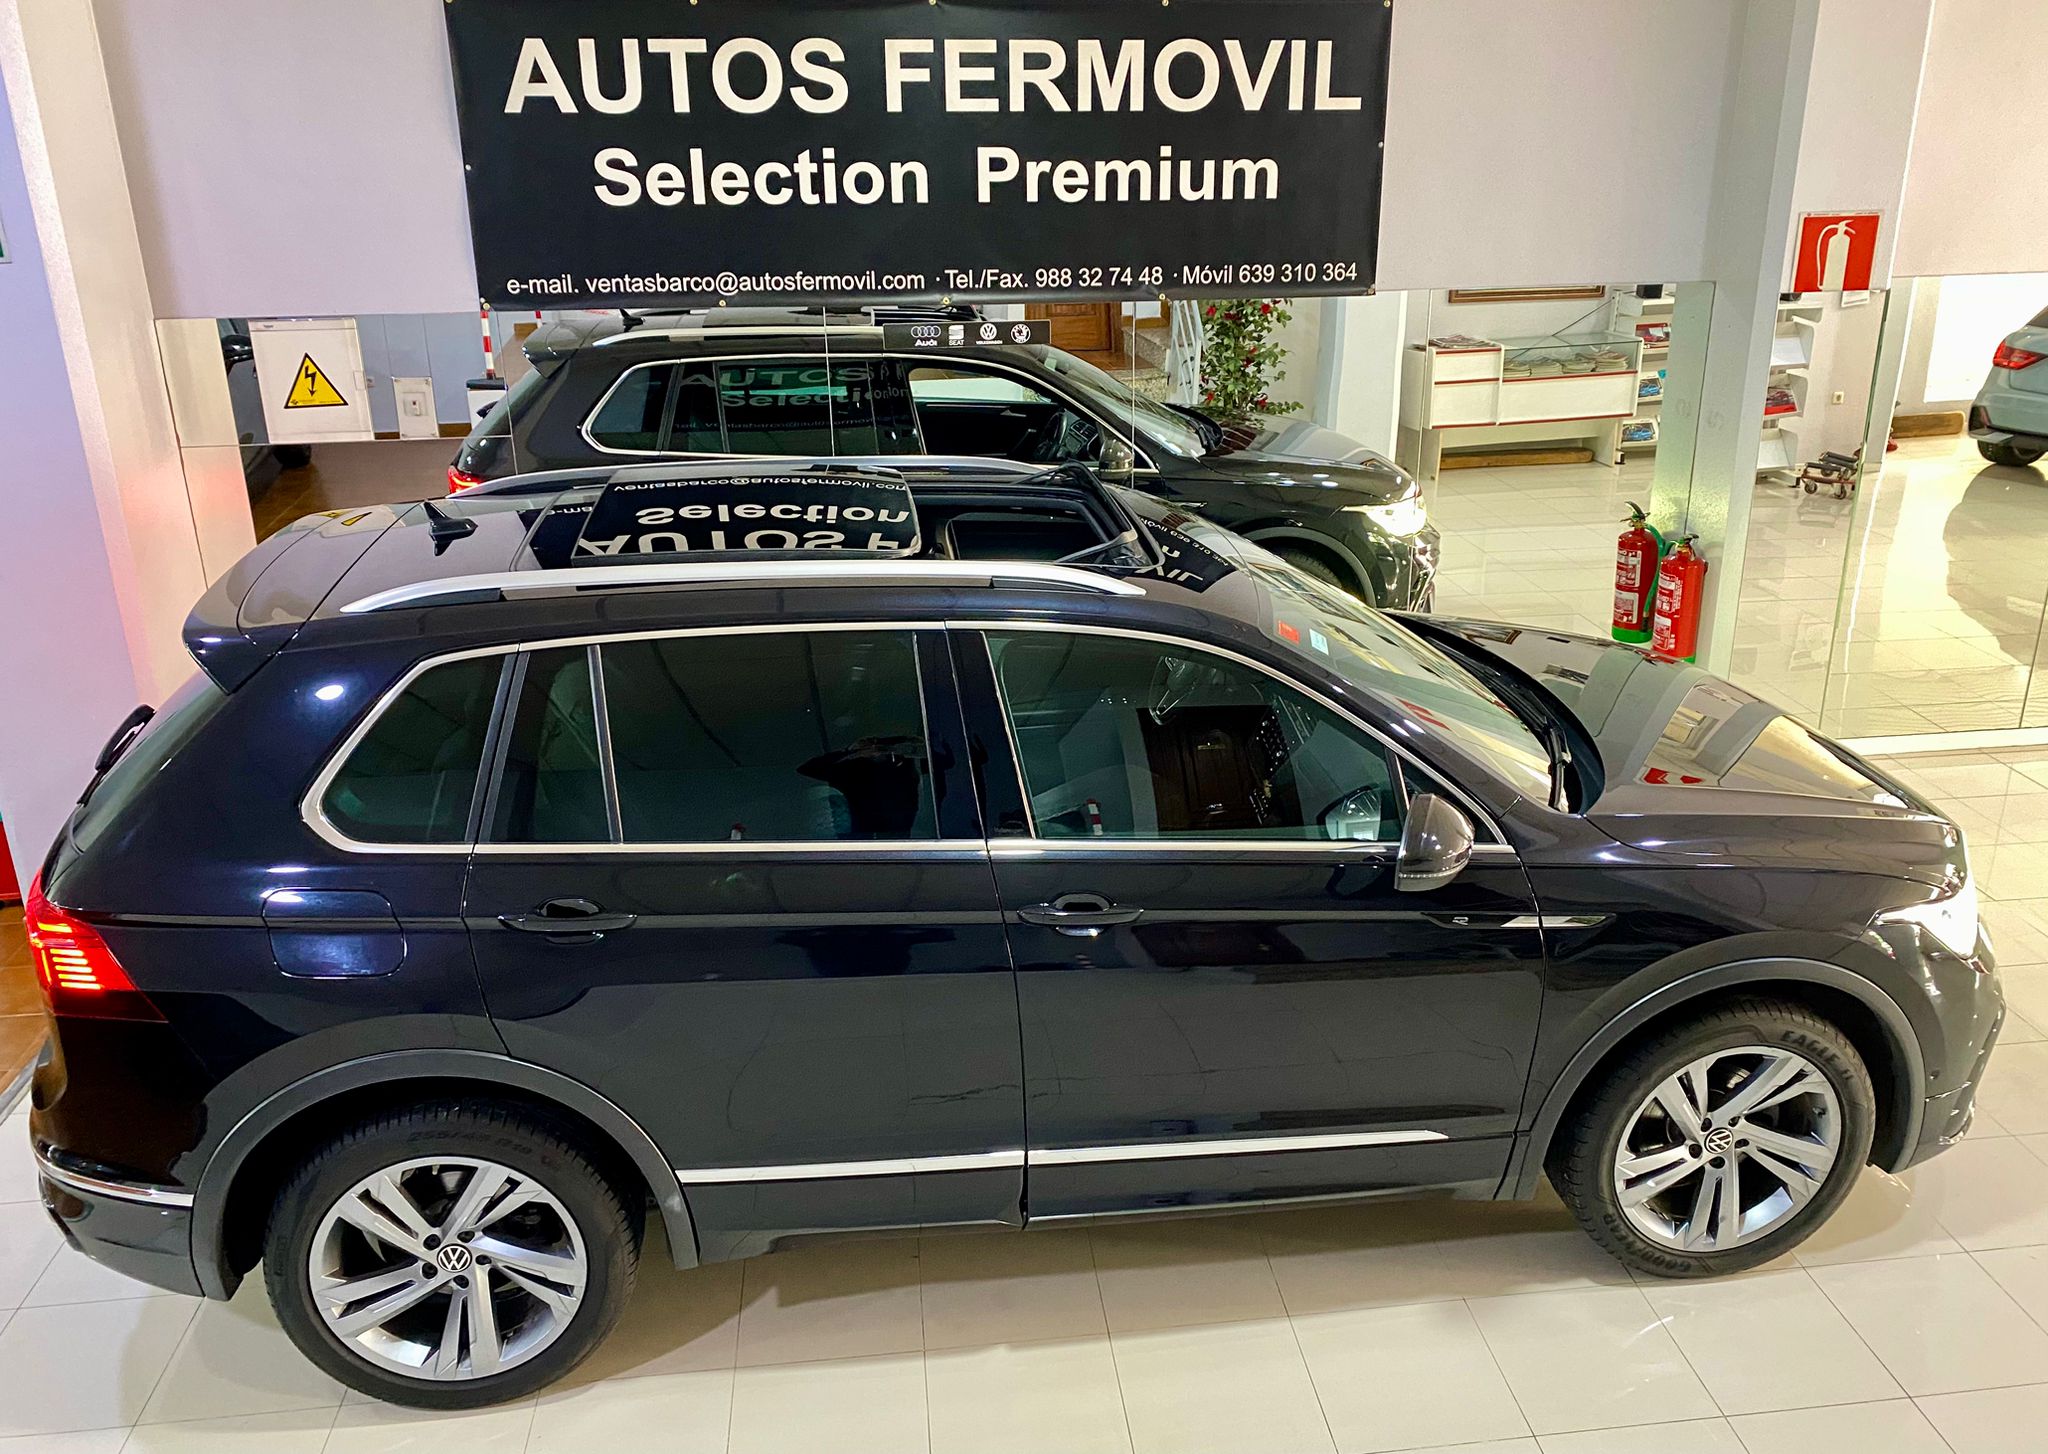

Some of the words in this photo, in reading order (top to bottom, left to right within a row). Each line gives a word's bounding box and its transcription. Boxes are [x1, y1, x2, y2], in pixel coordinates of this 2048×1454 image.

[504, 37, 849, 115] AUTOS
[884, 38, 1362, 113] FERMOVIL
[593, 147, 929, 206] Selection
[976, 145, 1279, 203] Premium
[507, 273, 579, 295] e-mail.
[584, 270, 925, 296] ventasbarco@autosfermovil.com
[944, 268, 1029, 290] Tel./Fax.
[1035, 267, 1073, 288] 988
[1078, 267, 1103, 287] 32
[1108, 267, 1133, 287] 74
[1137, 266, 1163, 286] 48
[1182, 264, 1233, 285] Móvil
[1238, 263, 1275, 284] 639
[1280, 262, 1317, 283] 310
[1322, 262, 1358, 282] 364
[915, 339, 938, 347] Audi
